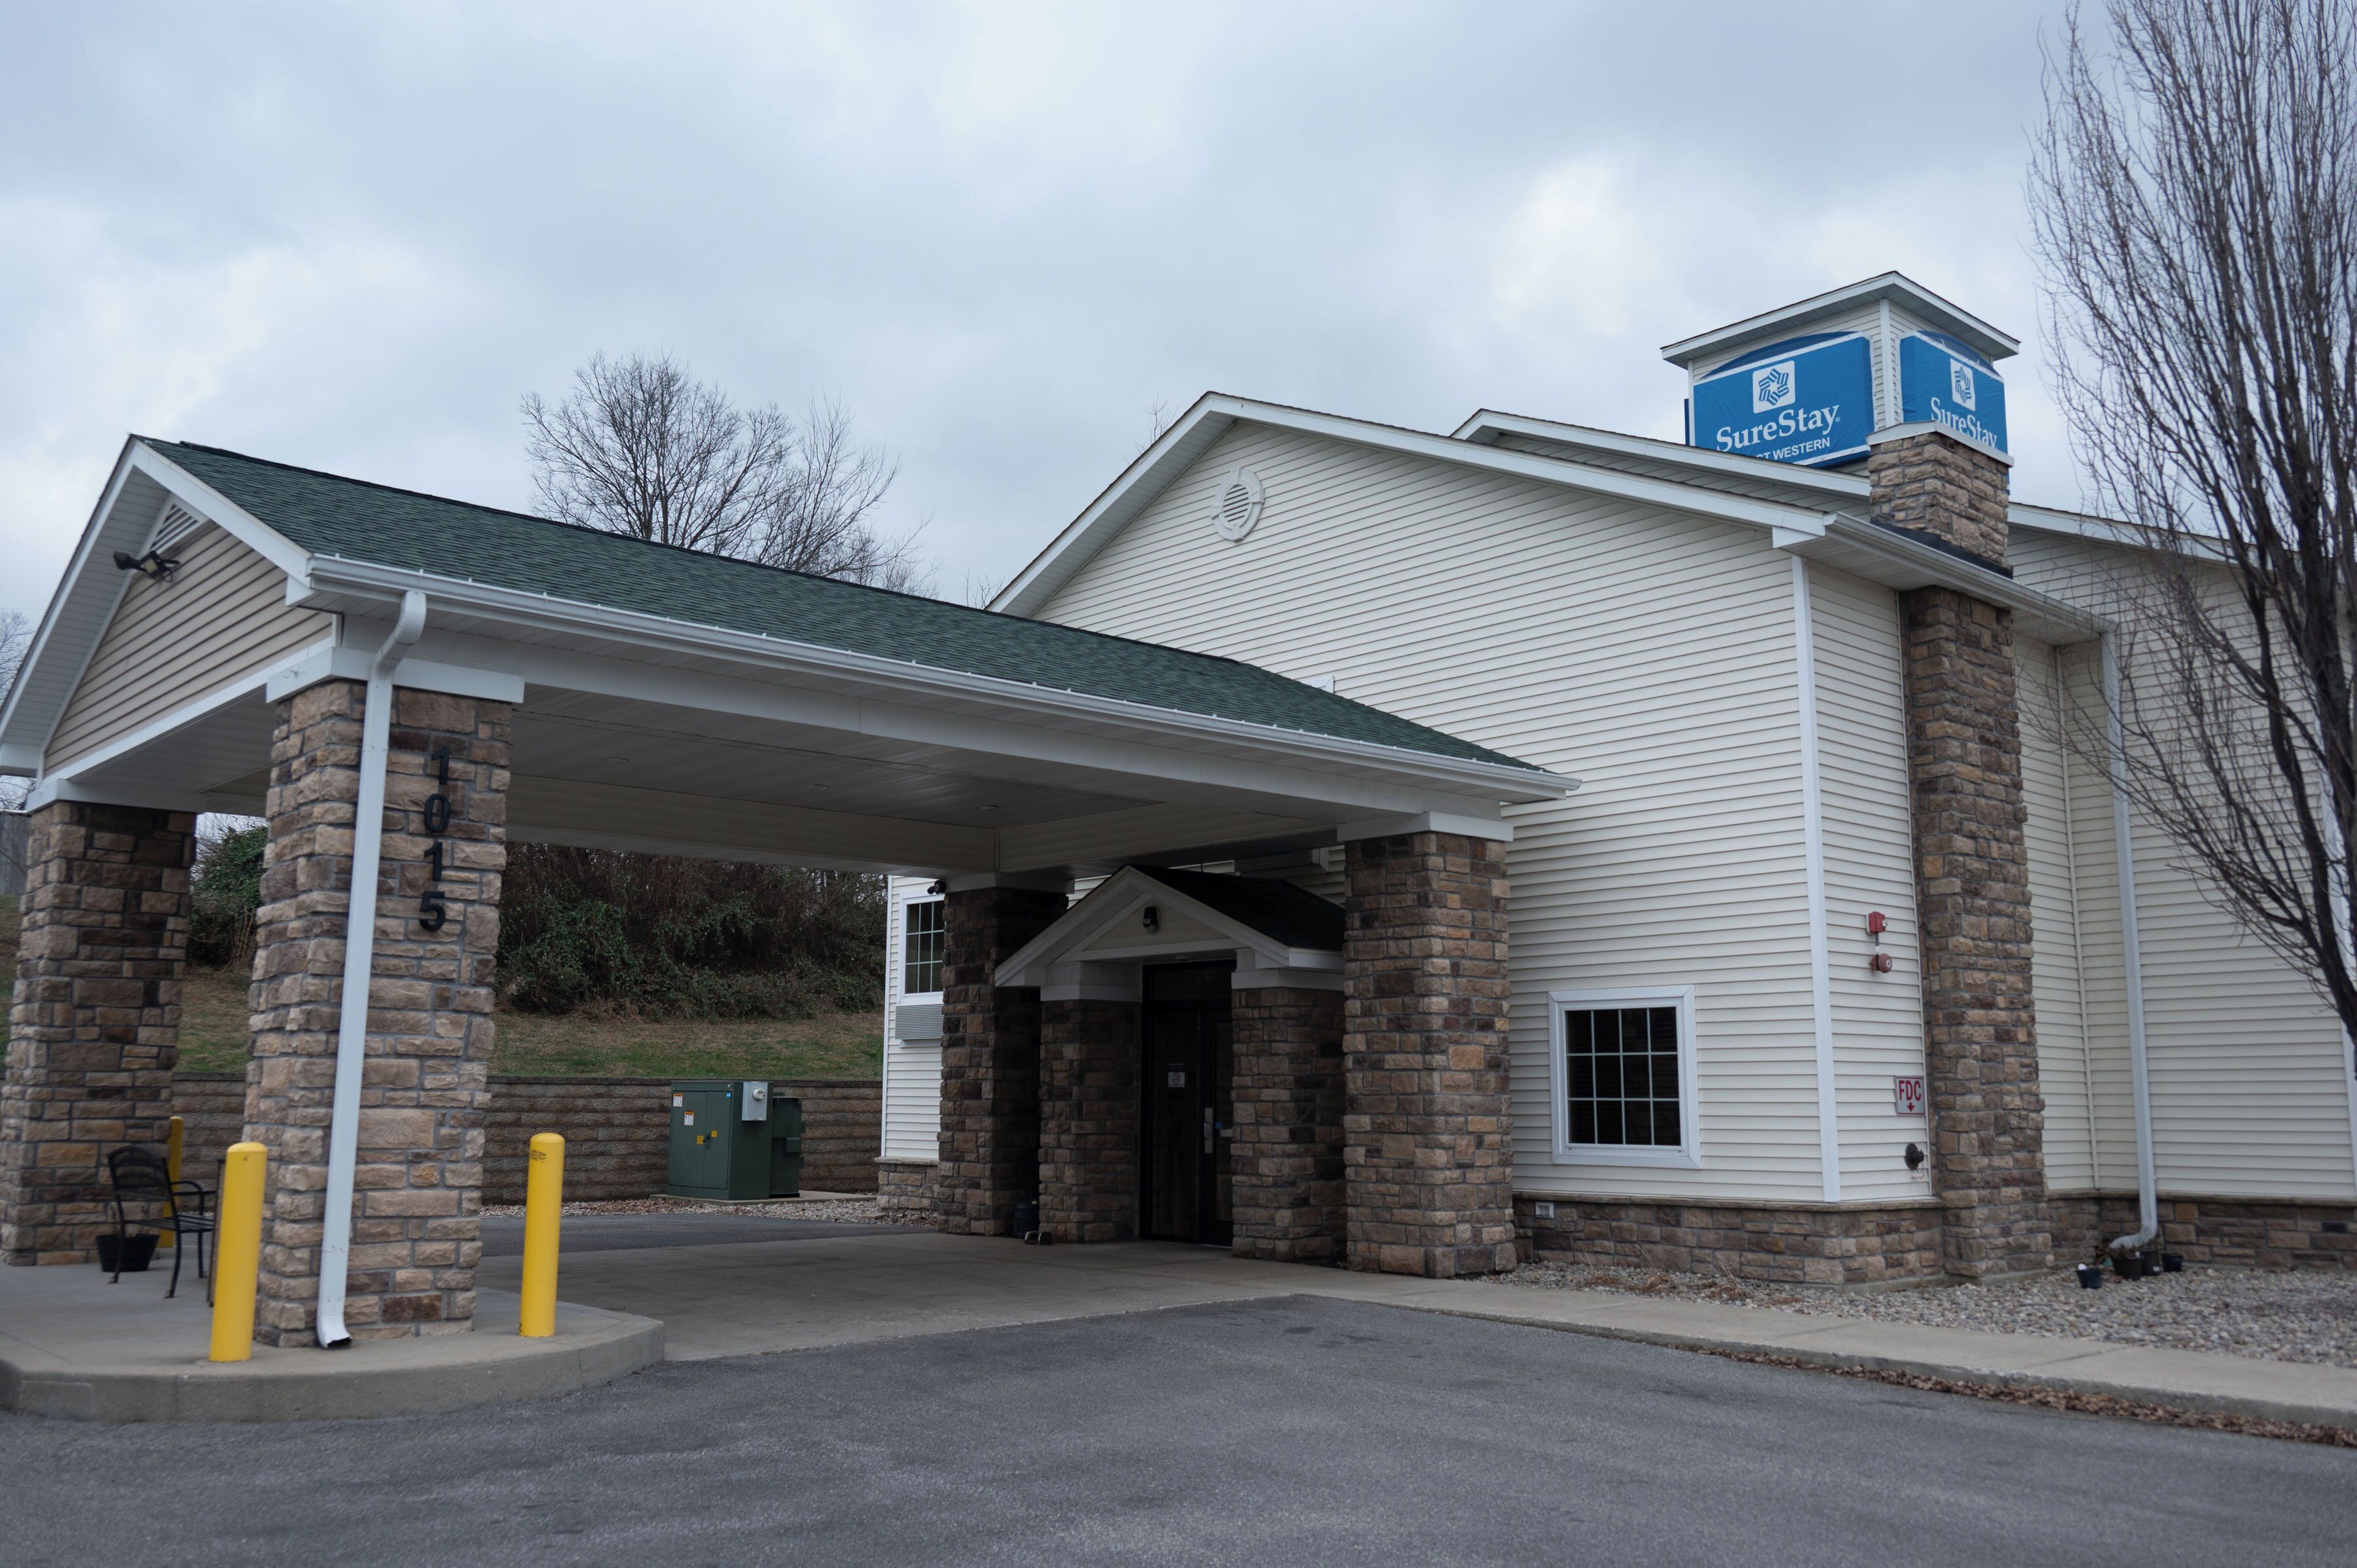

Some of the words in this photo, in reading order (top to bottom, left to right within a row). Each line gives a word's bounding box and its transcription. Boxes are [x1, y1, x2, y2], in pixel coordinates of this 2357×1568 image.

[1716, 404, 1840, 452] SureStay
[1931, 397, 1998, 449] SureStay
[1773, 437, 1831, 460] WESTERN
[418, 746, 451, 932] 1015
[1899, 1080, 1922, 1101] FDC
